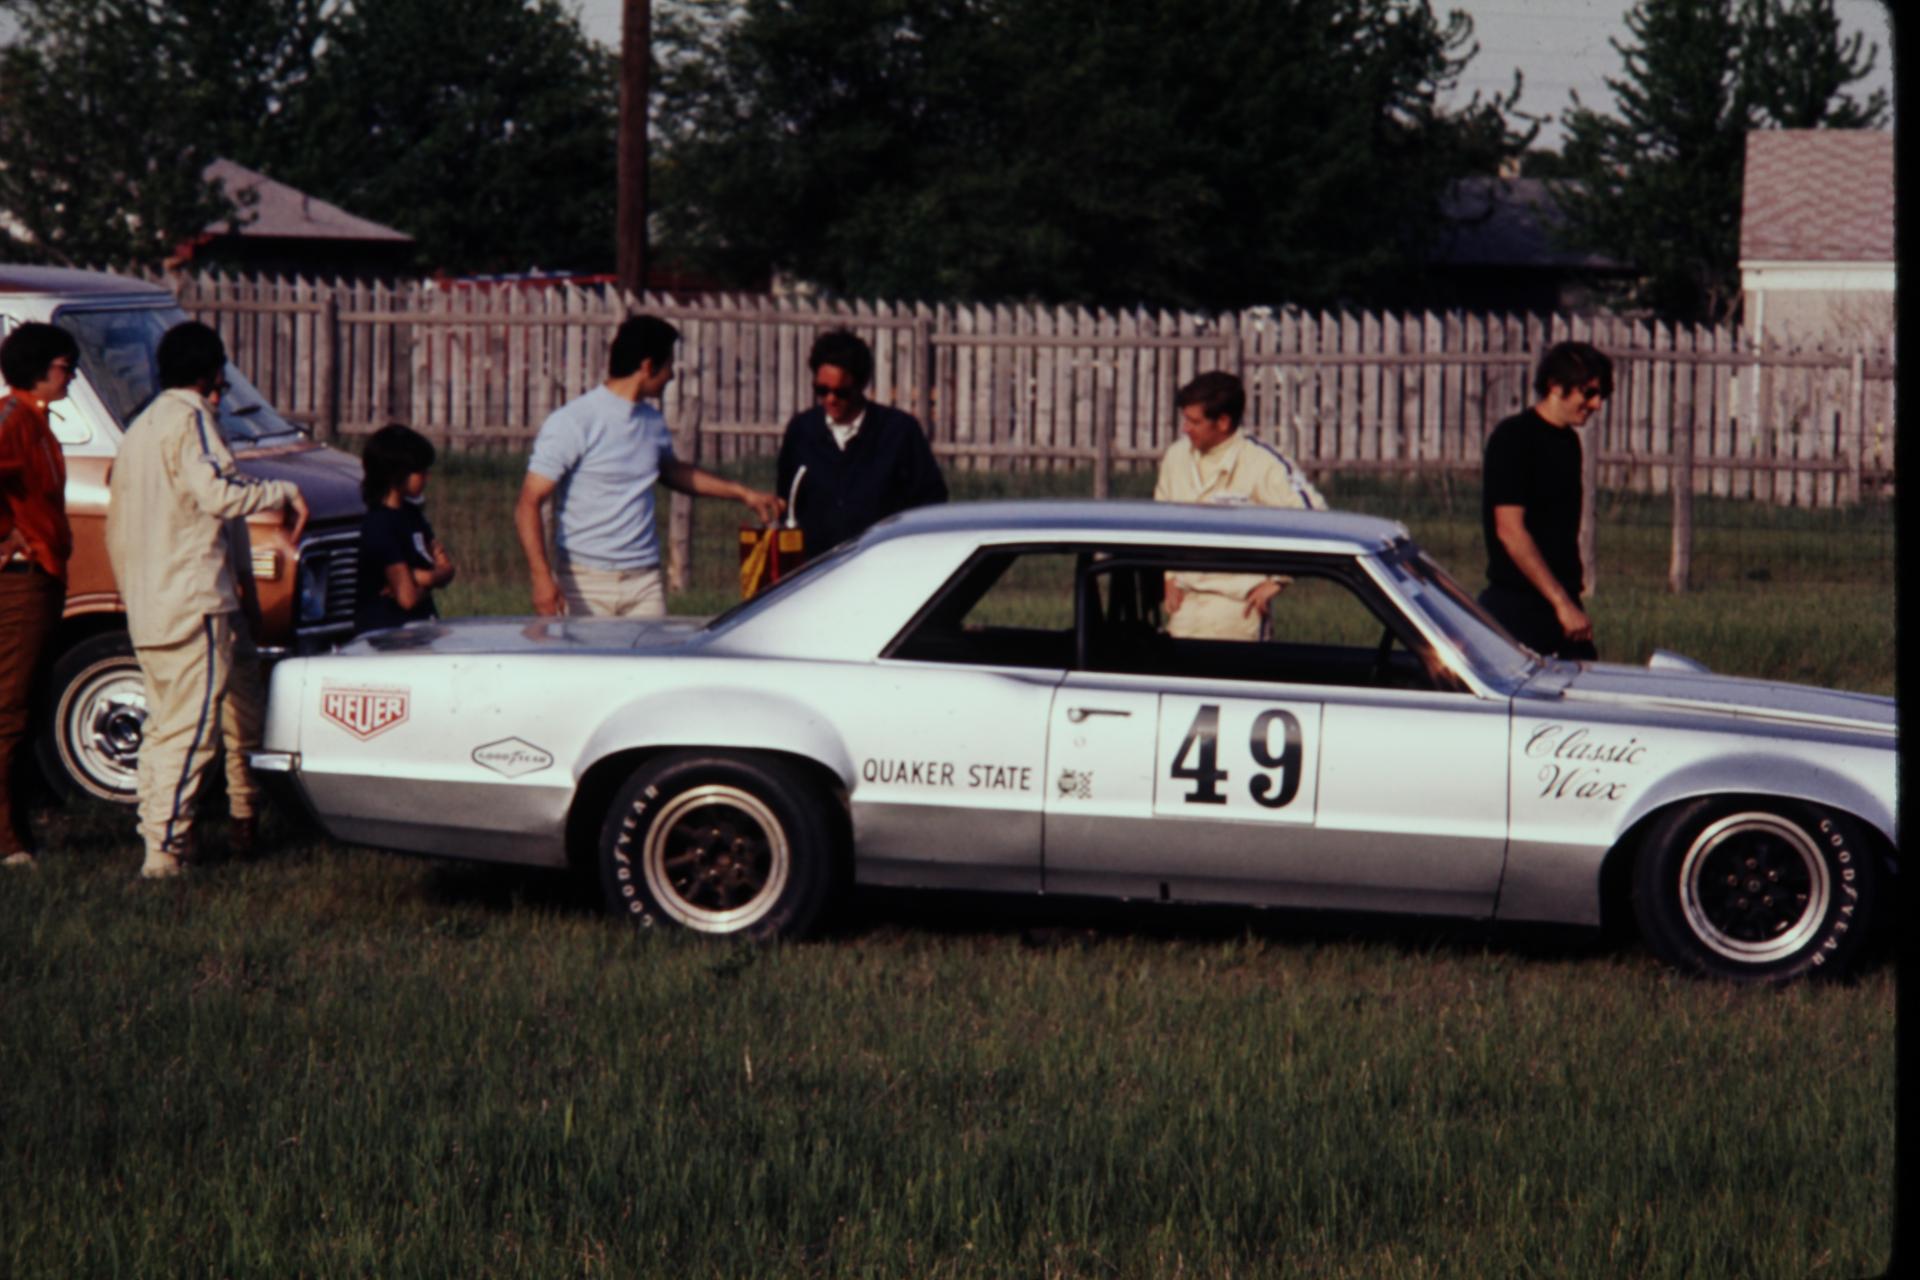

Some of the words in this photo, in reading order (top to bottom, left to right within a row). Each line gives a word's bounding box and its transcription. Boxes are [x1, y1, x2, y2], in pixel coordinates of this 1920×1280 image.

[327, 694, 403, 732] HEUER
[1170, 704, 1304, 809] 49
[1524, 722, 1647, 765] Classic
[862, 758, 955, 786] QUAKER
[968, 764, 1032, 791] STATE
[1538, 764, 1627, 801] Wax
[613, 784, 659, 928] GOODYEAR
[1811, 818, 1858, 966] GOODYEAR
